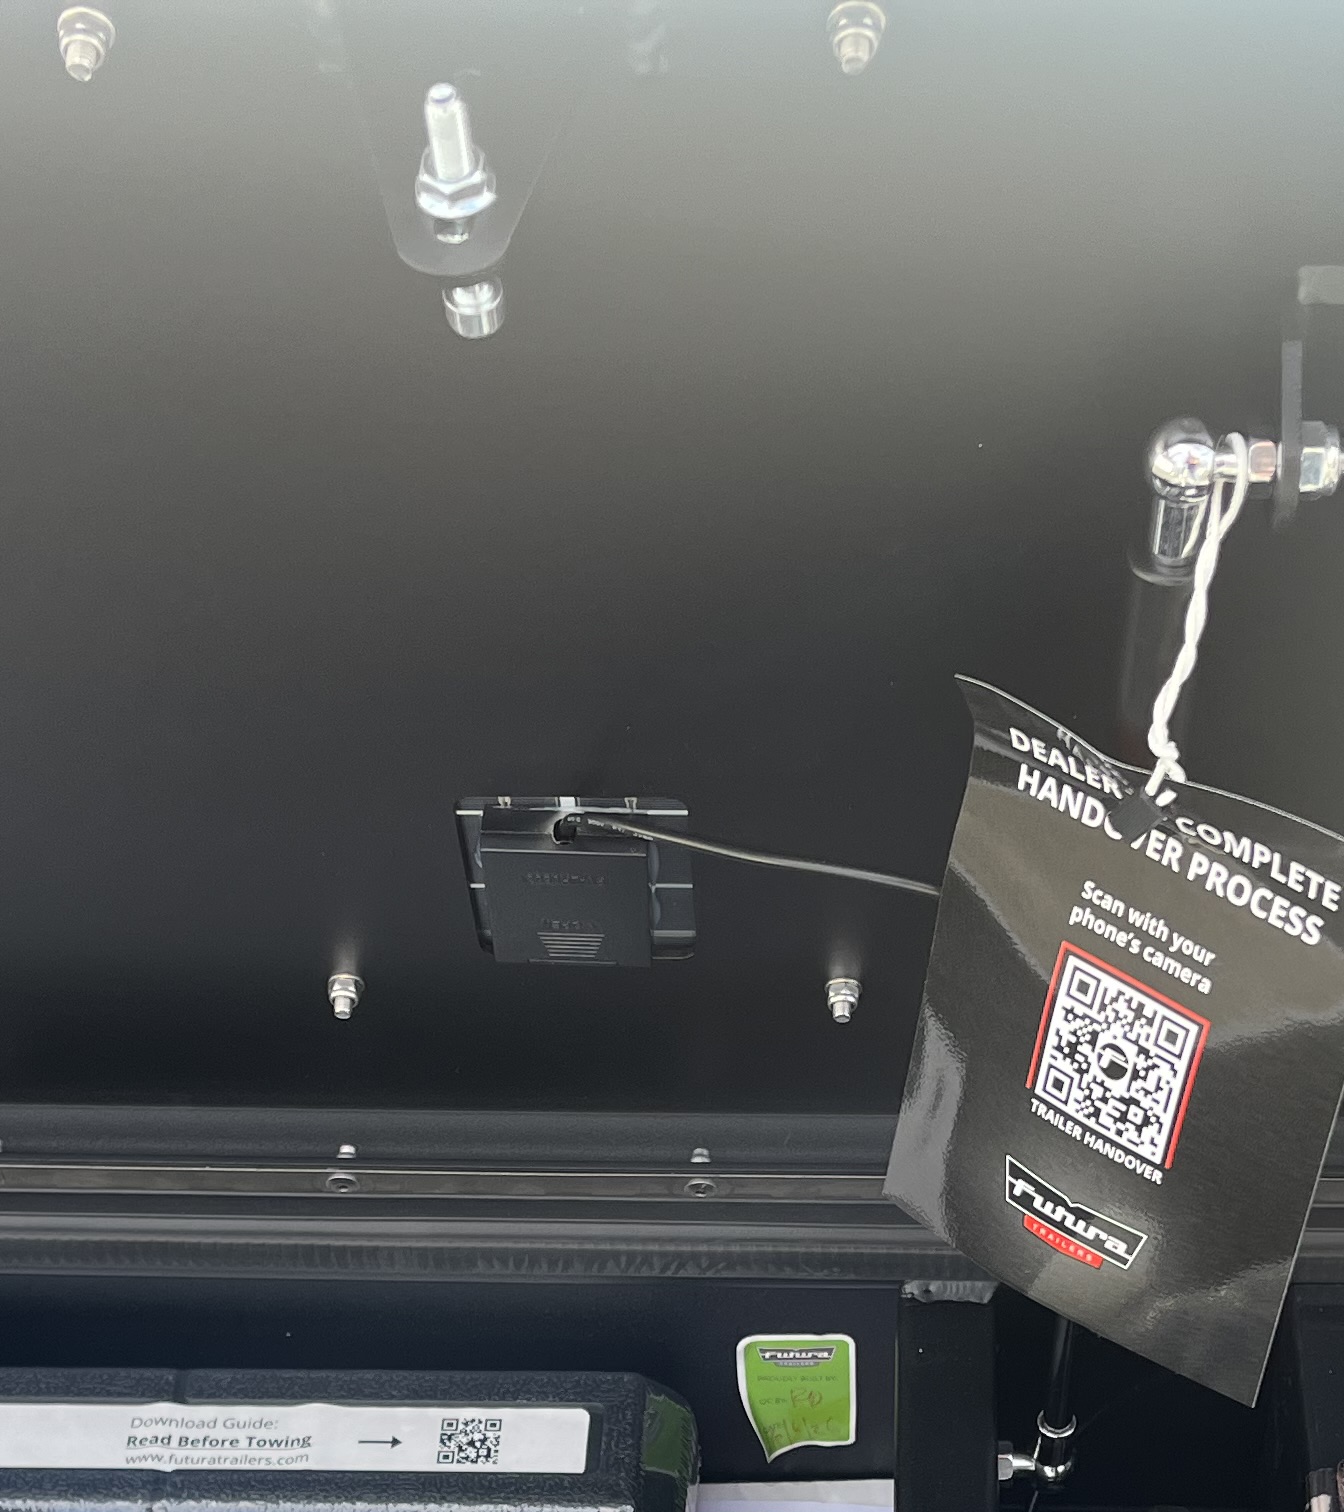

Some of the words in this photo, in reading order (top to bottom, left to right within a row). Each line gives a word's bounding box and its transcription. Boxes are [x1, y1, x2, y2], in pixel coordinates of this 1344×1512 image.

[1009, 727, 1124, 800] DEALER
[1175, 816, 1343, 912] COMPLETE
[1081, 880, 1126, 918] Scan
[1128, 906, 1170, 942] with
[1171, 931, 1216, 967] your
[1186, 851, 1325, 946] PROCESS
[1069, 905, 1141, 955] phone's
[1142, 947, 1212, 995] camera
[1030, 1098, 1082, 1142] TRAILER
[1083, 1131, 1165, 1186] HANDOVER
[1031, 1222, 1094, 1263] TRAILERS
[125, 1453, 311, 1467] www.futuratrailers.com
[126, 1434, 173, 1448] Read
[178, 1435, 241, 1448] Before
[246, 1434, 313, 1449] Towing
[130, 1416, 218, 1430] Download
[222, 1417, 280, 1431] Guide:
